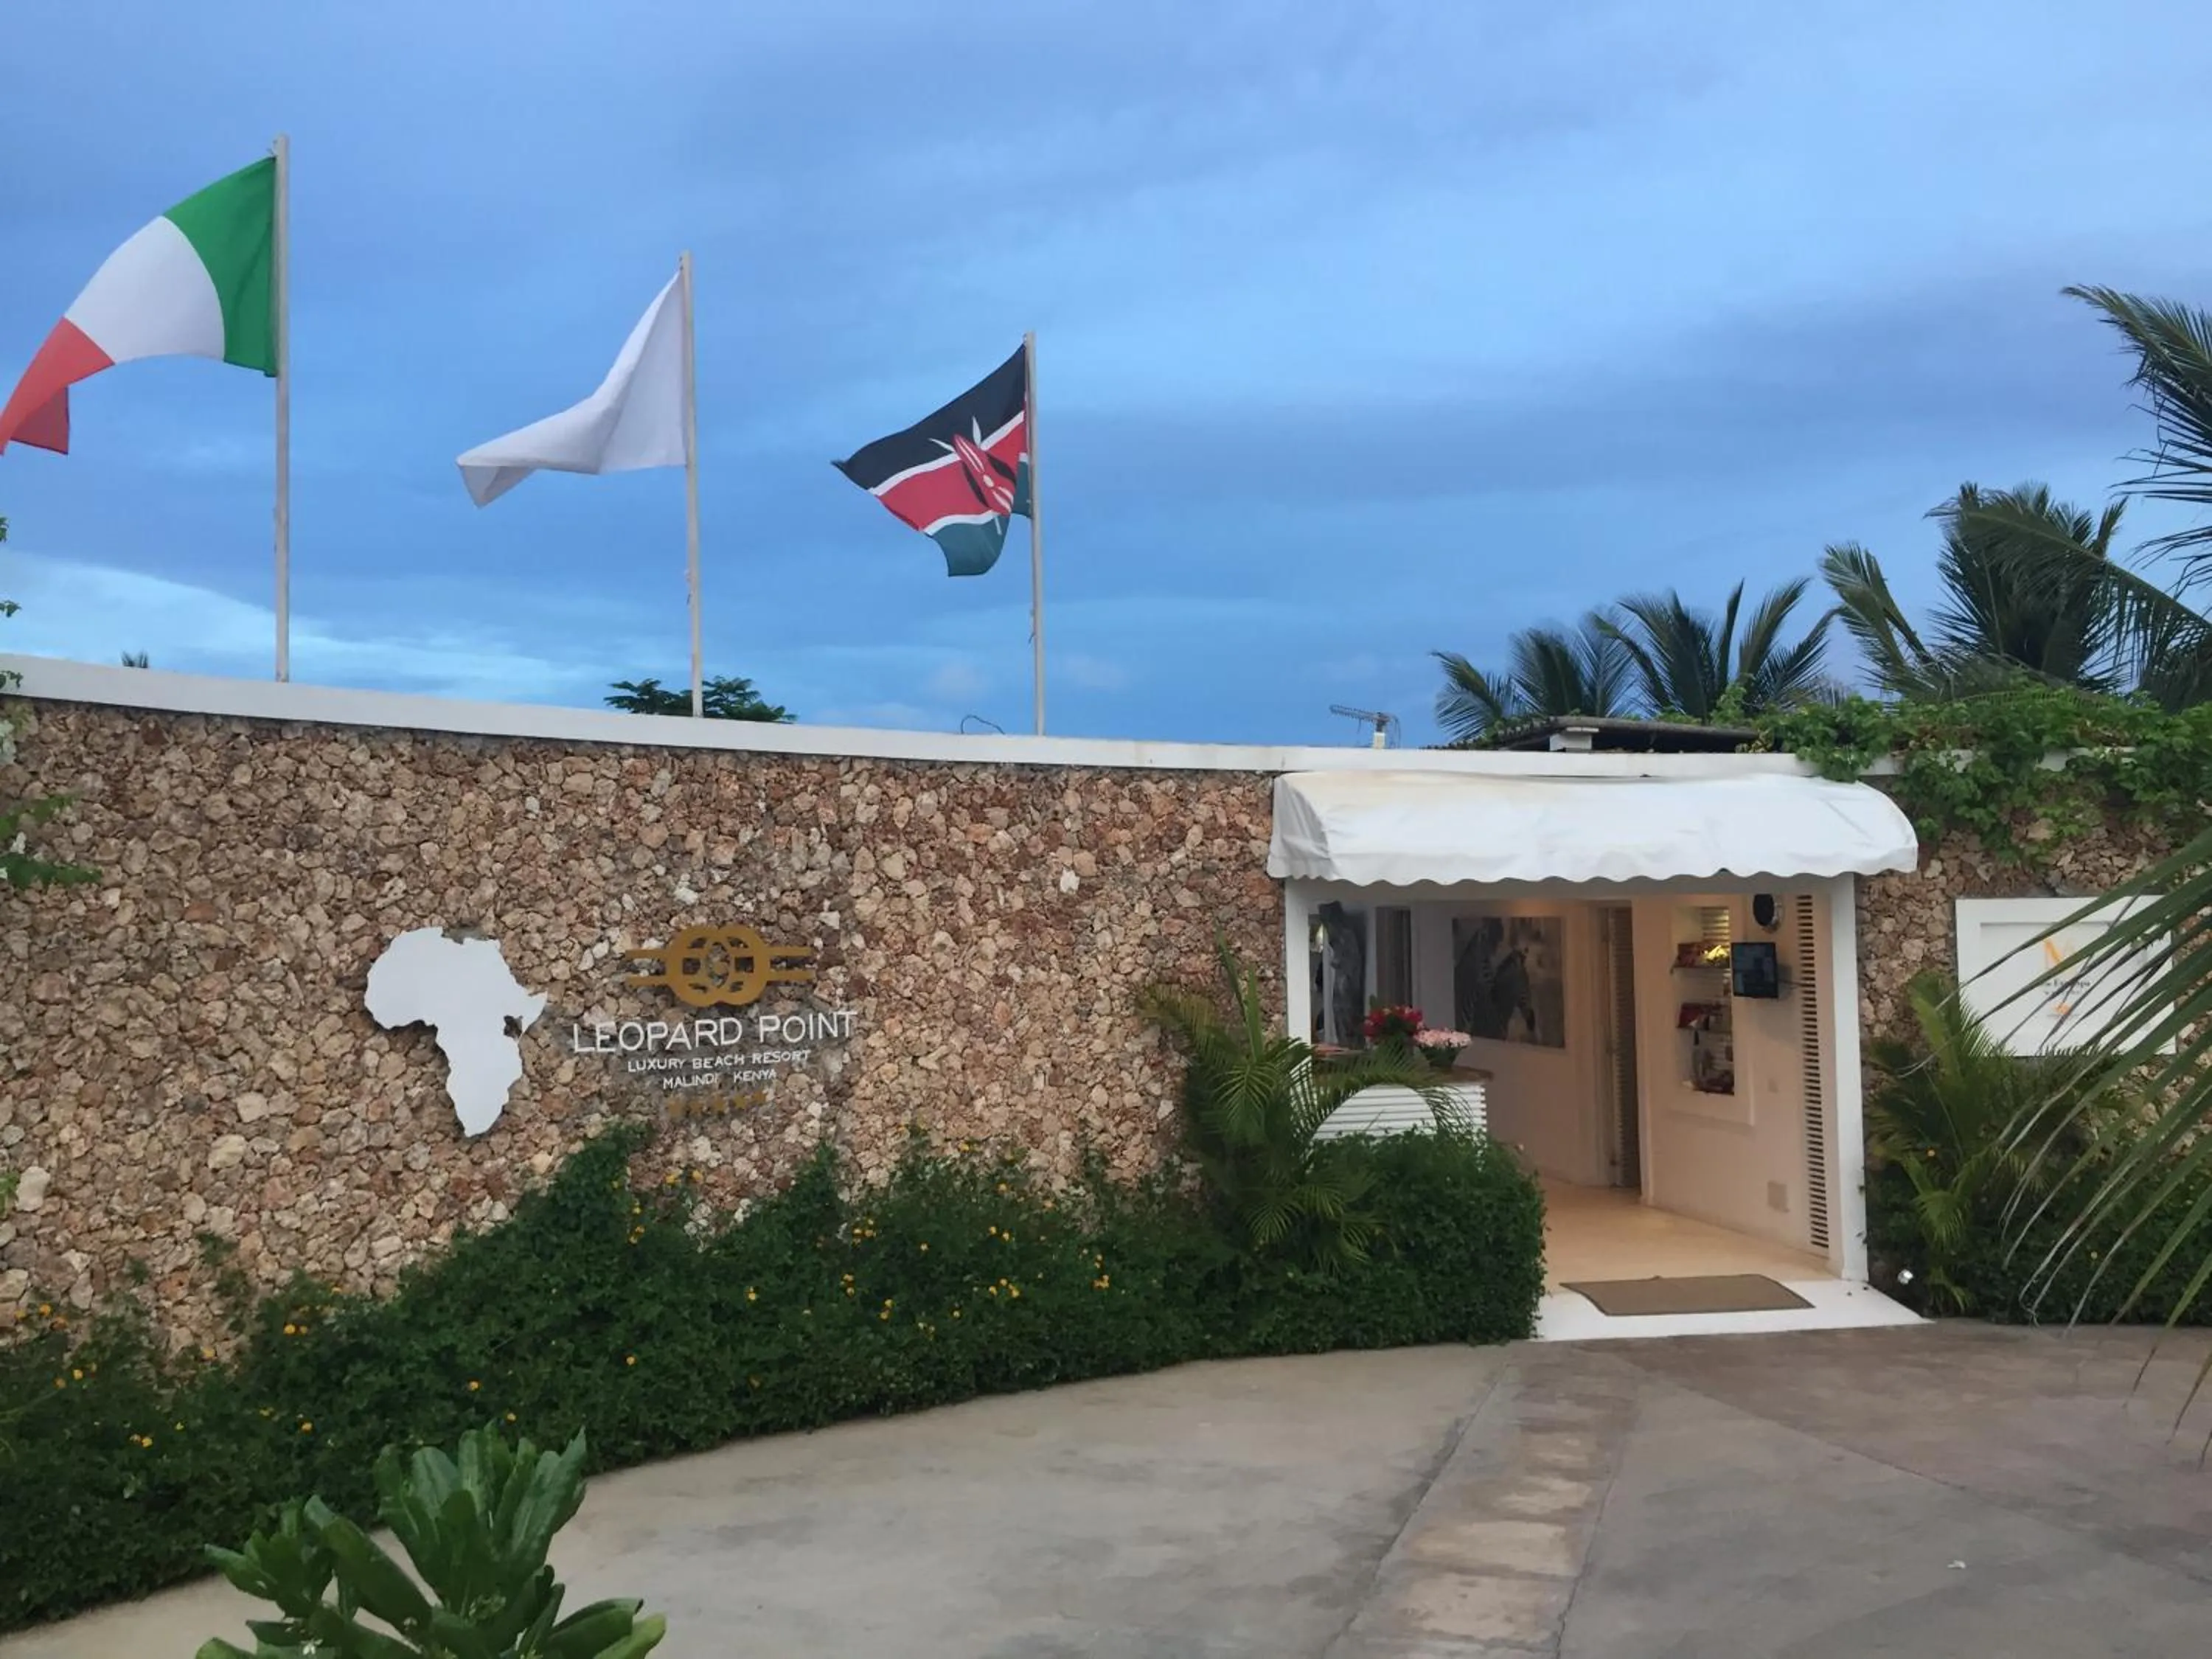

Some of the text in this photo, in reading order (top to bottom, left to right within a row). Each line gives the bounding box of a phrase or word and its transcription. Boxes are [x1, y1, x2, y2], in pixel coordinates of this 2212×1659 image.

[573, 1011, 858, 1053] LEOPARD POINT
[627, 1049, 810, 1073] LUXURY BEACH RESORT
[663, 1068, 777, 1089] MALINDI KENYA
